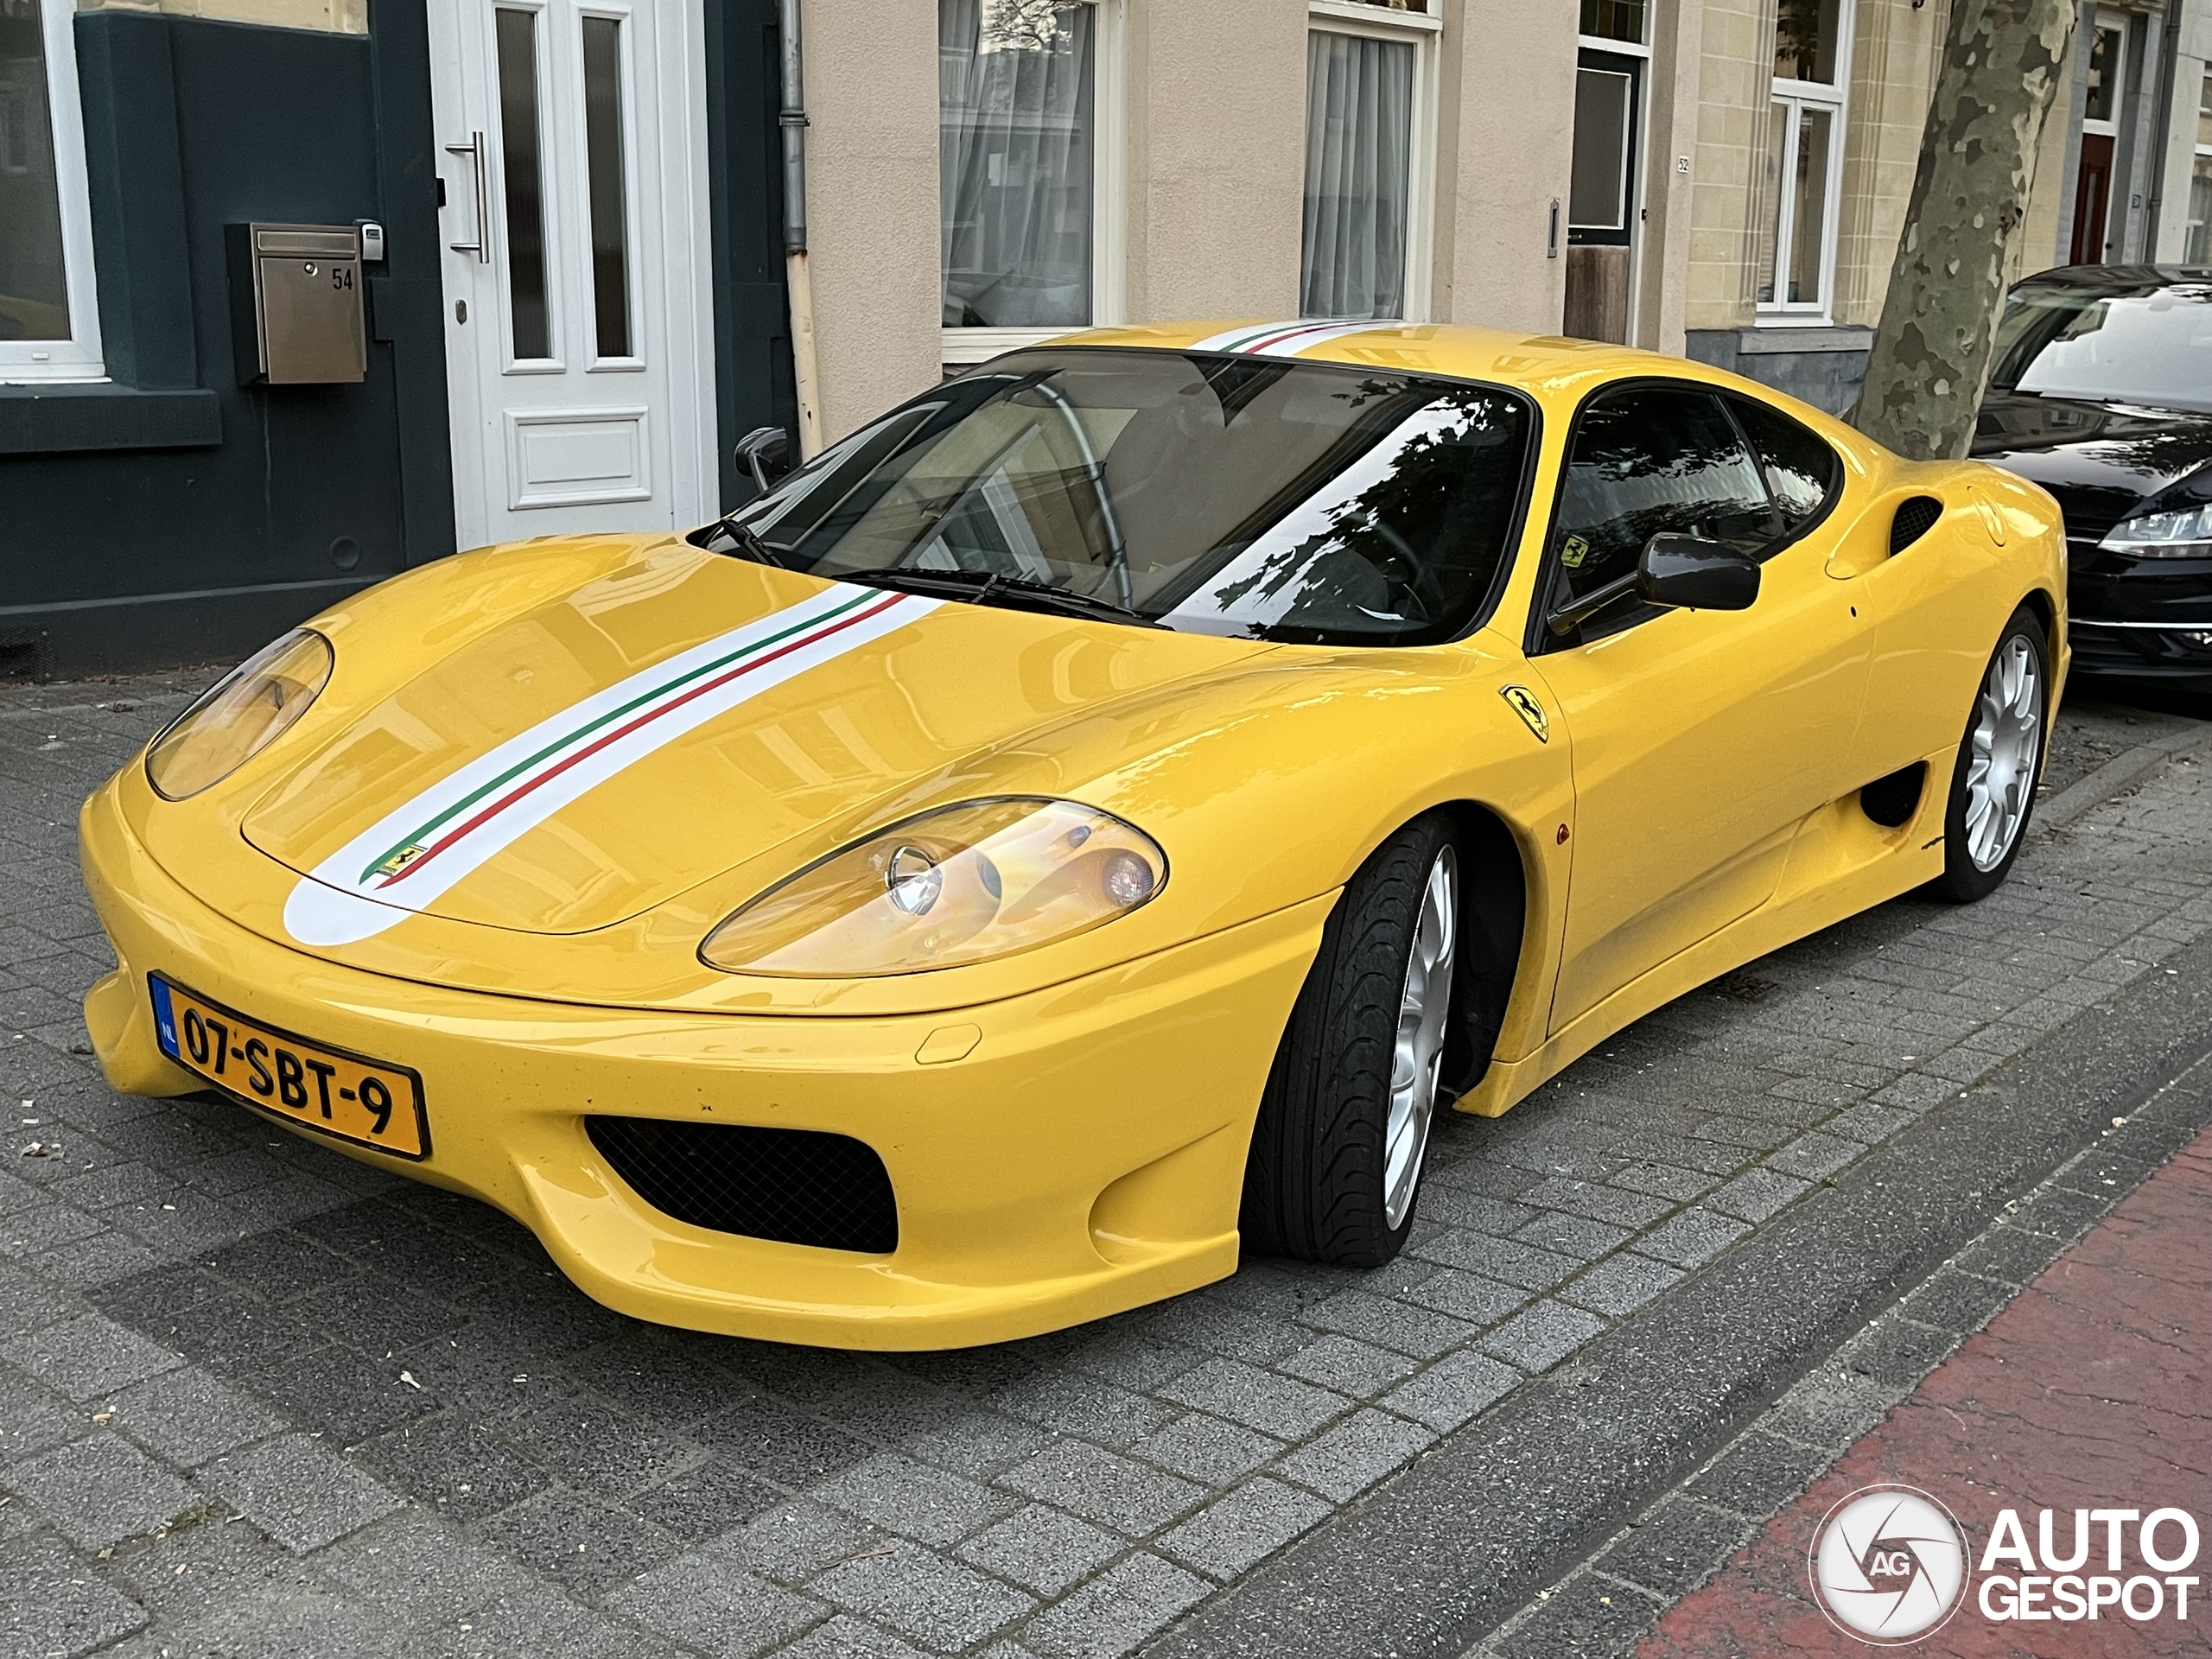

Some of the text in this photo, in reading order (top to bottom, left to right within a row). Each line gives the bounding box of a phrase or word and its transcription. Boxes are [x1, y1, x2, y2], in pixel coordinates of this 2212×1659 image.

[1679, 158, 1688, 171] 52
[332, 268, 353, 290] 54
[162, 1021, 176, 1044] NL
[183, 1007, 392, 1135] 07-SBT-9
